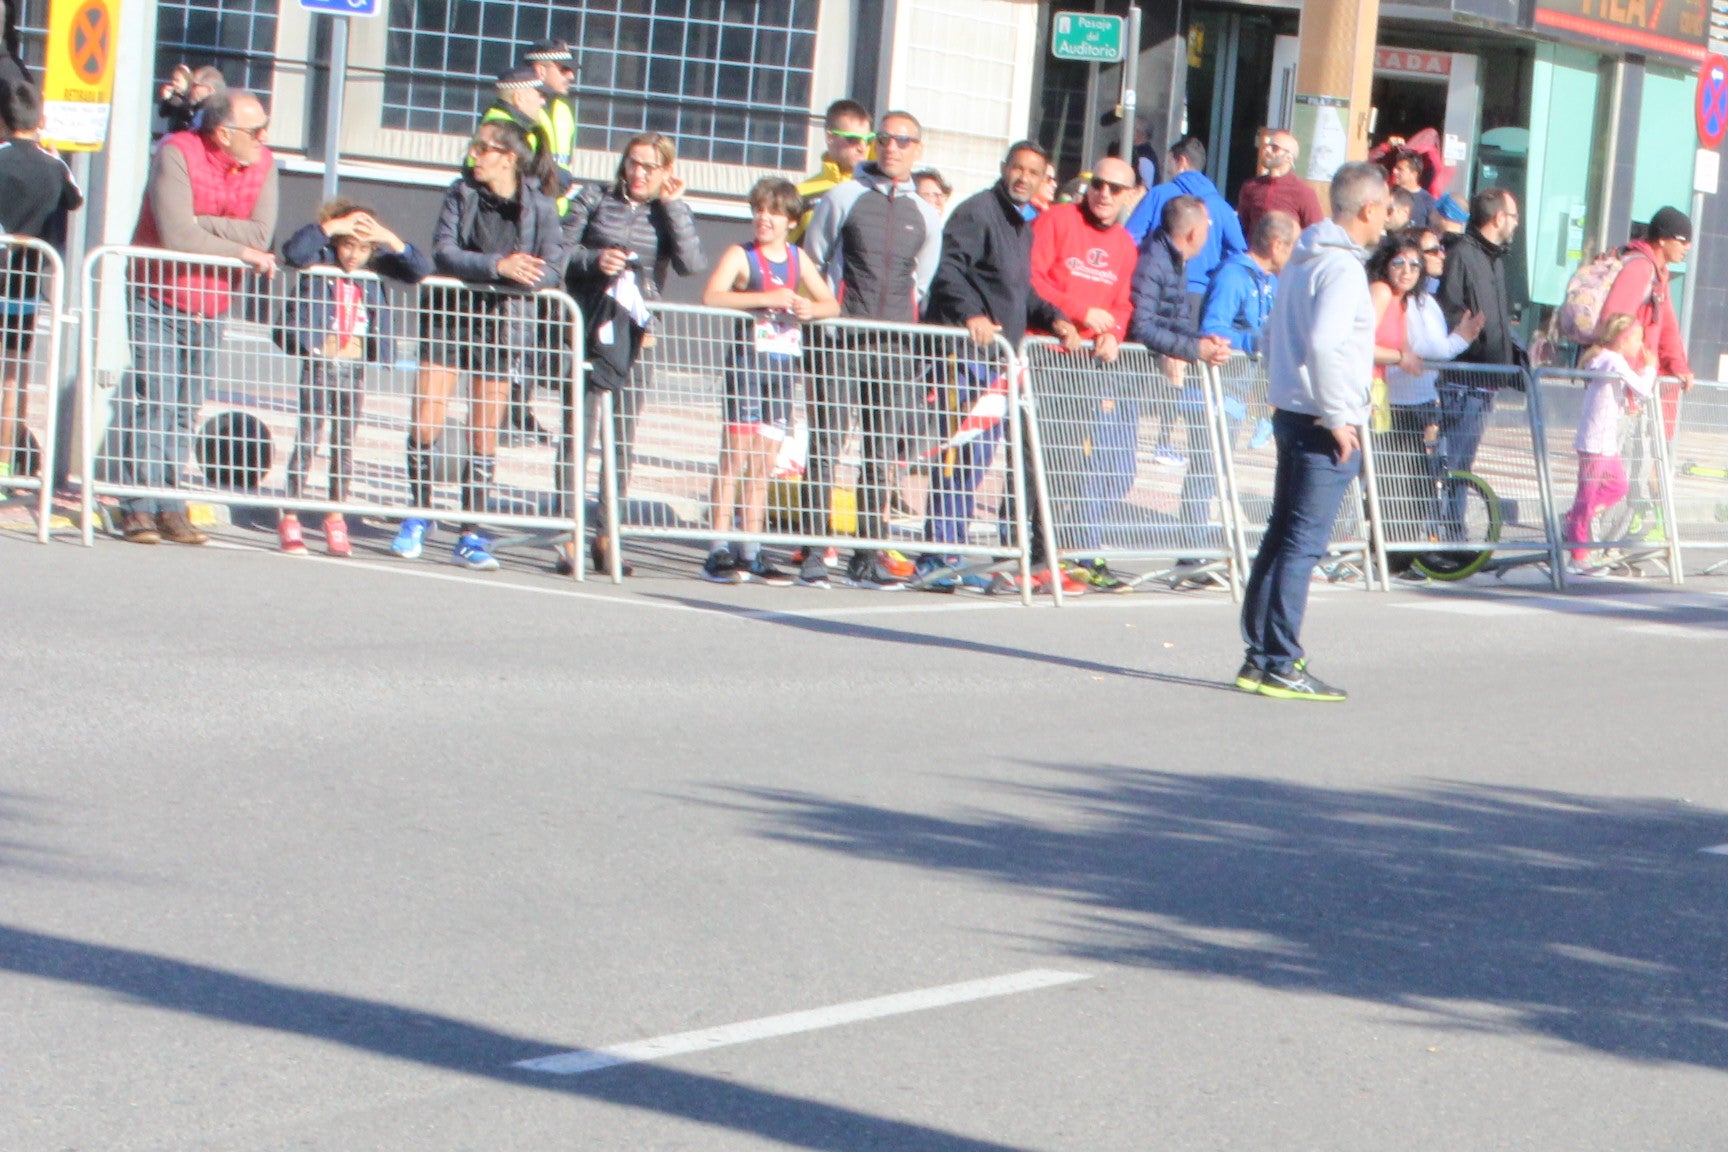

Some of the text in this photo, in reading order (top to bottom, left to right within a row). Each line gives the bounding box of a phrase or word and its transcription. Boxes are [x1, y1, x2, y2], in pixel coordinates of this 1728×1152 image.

[1078, 16, 1112, 32] Pasaje
[1087, 31, 1100, 41] del
[1059, 40, 1118, 57] Auditorio
